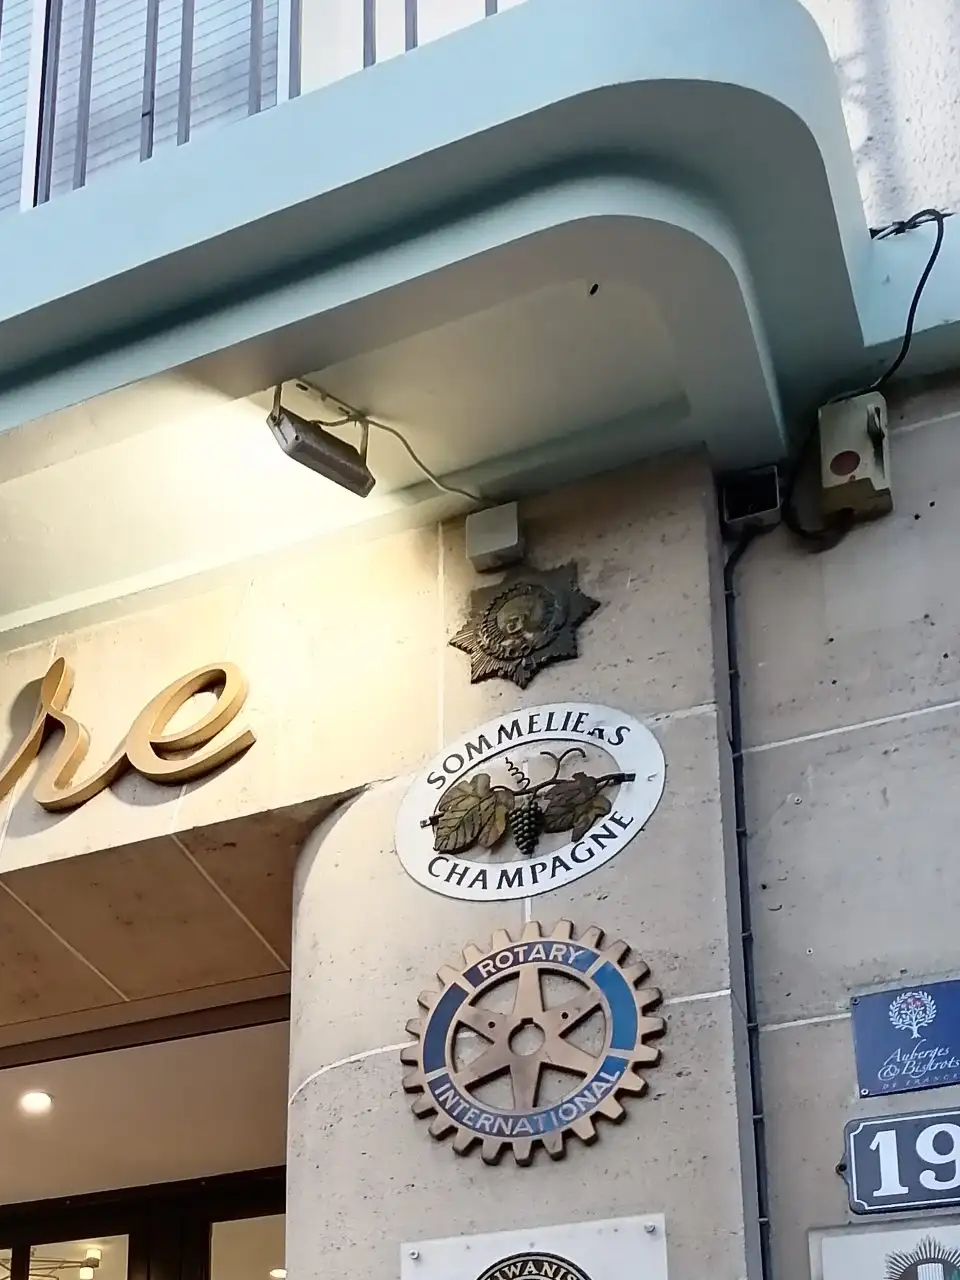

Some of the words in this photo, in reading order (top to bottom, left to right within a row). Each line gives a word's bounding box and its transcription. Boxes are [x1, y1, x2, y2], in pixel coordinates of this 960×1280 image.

[427, 810, 634, 890] CHAMPAGNE
[477, 944, 585, 978] ROTARY
[883, 1039, 950, 1077] Auberges
[435, 1070, 621, 1136] INTERNATIONAL
[869, 1122, 960, 1198] 19
